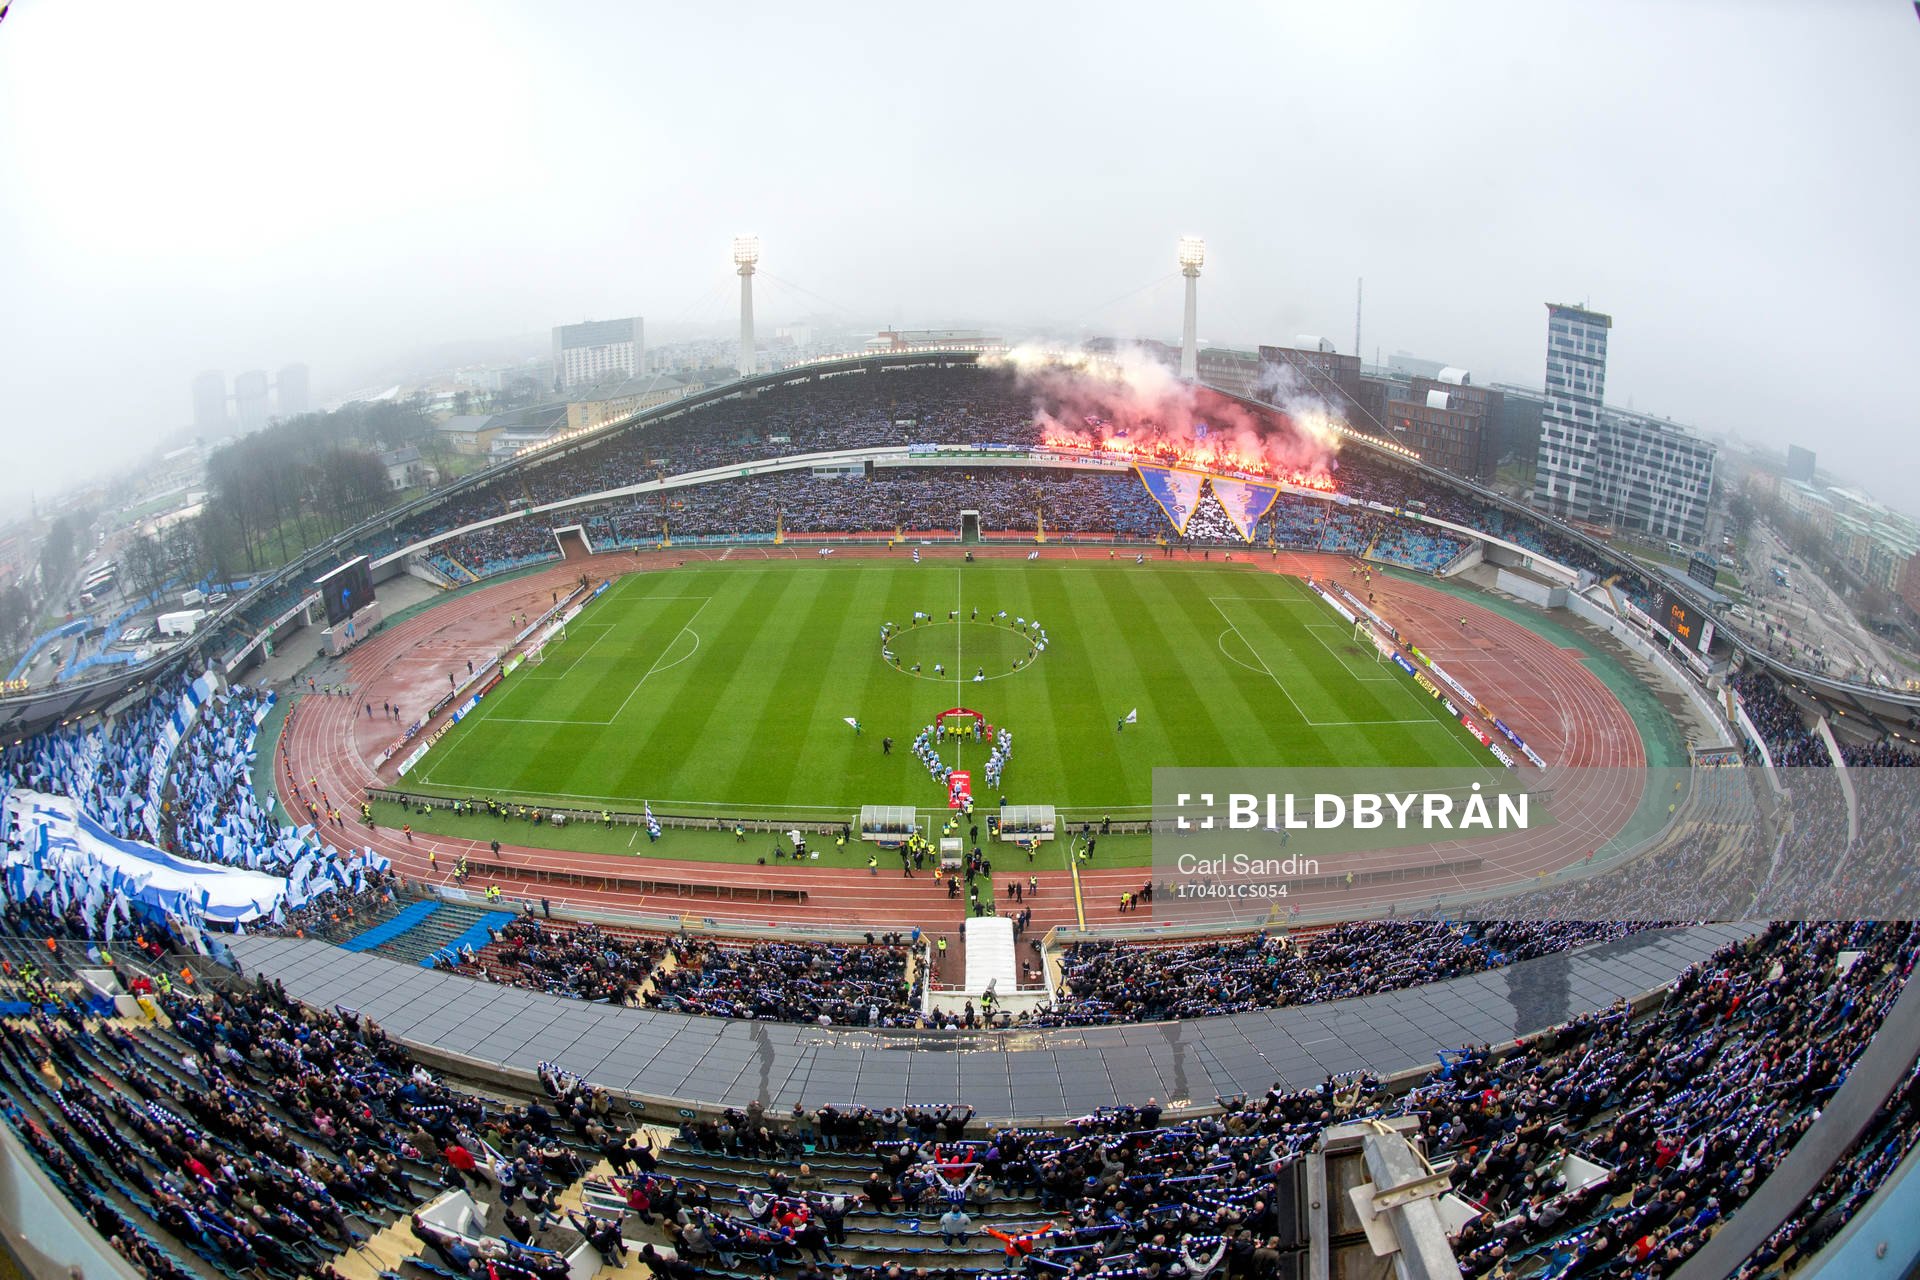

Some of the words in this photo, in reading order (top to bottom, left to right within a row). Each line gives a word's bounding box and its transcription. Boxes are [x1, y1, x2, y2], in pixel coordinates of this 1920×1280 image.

[434, 718, 455, 740] XL-BYGG
[1465, 720, 1485, 742] Scandic
[1489, 743, 1514, 769] SERNEKE
